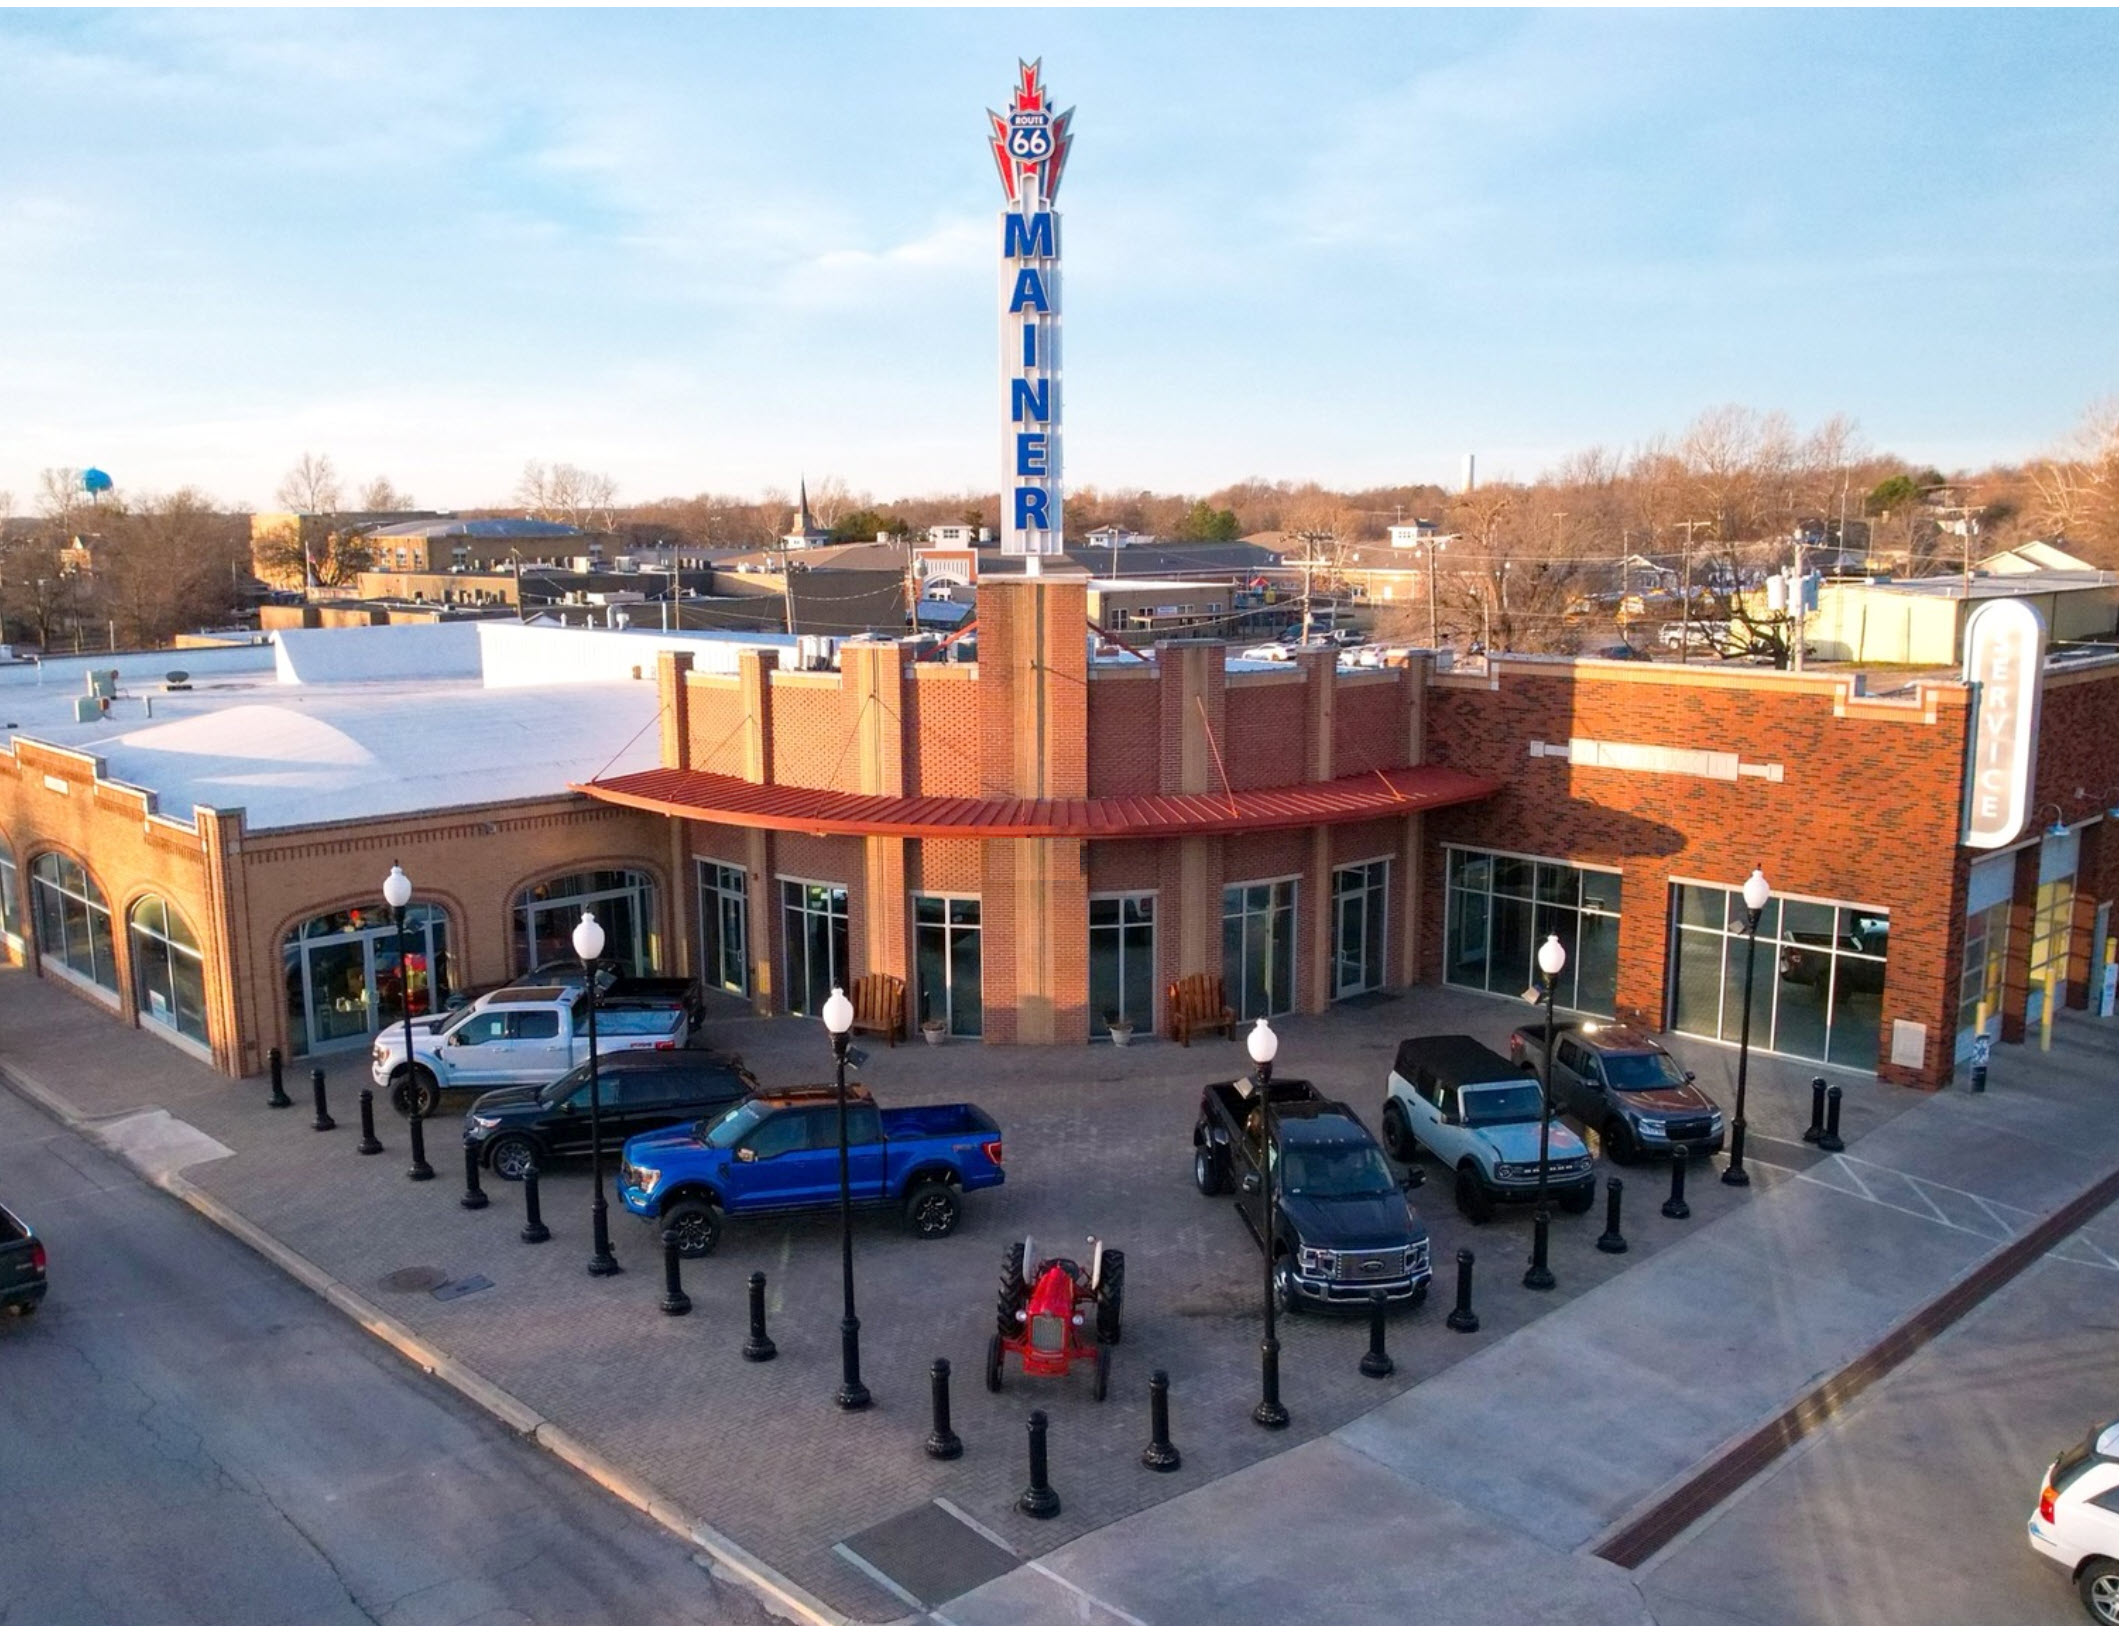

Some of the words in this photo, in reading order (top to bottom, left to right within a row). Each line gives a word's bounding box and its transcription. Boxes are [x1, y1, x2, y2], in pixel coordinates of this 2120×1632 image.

[1015, 115, 1044, 125] ROUTE
[1013, 129, 1047, 155] 66
[1003, 212, 1055, 531] MAINER
